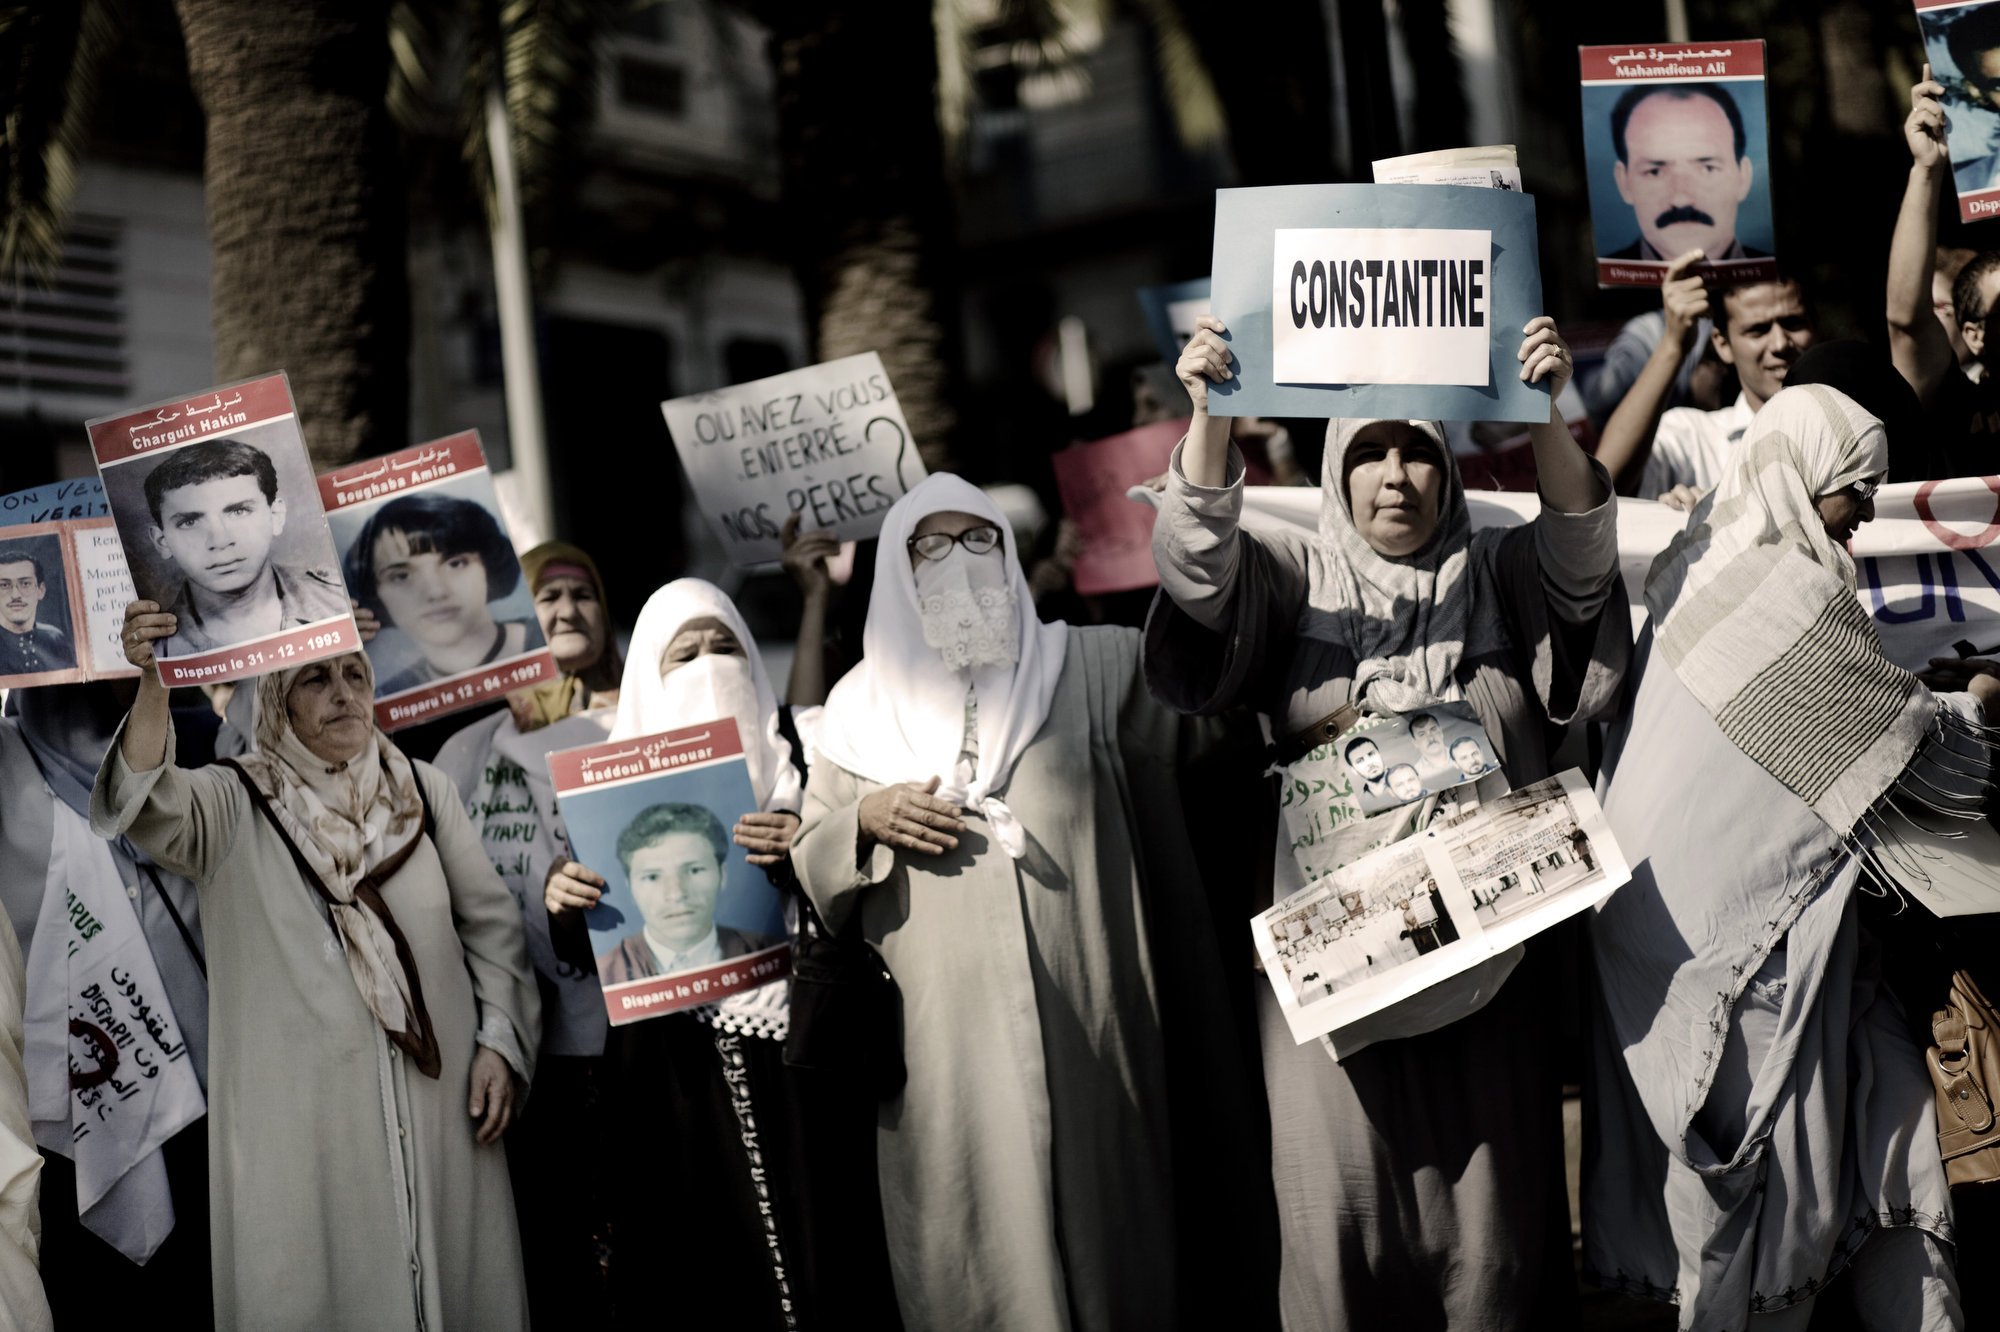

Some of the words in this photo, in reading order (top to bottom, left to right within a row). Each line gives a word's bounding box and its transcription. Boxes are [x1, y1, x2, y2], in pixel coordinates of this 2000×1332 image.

[1616, 62, 1703, 78] Mahamdioua
[1706, 62, 1726, 75] Ali
[1969, 200, 2000, 214] Disp
[1290, 260, 1484, 329] CONSTANTINE
[129, 408, 181, 438] حكيم
[741, 394, 807, 437] AVEZ
[816, 375, 887, 415] VOUS
[132, 424, 196, 450] Charguit
[200, 410, 247, 432] Hakim
[3, 493, 39, 510] ON
[57, 482, 103, 500] VEU
[337, 476, 405, 505] Boughaba
[411, 462, 456, 484] Amina
[720, 502, 780, 543] NOS
[92, 601, 107, 612] de
[97, 583, 118, 599] par
[174, 662, 227, 680] Disparu
[231, 658, 244, 671] le
[248, 651, 264, 666] 31
[278, 643, 295, 658] 12
[308, 631, 341, 650] 1993
[389, 696, 439, 721] Disparu
[441, 691, 454, 705] le
[484, 677, 500, 692] 04
[511, 662, 542, 686] 1997
[582, 758, 644, 784] Maddoui
[649, 746, 713, 770] Menouar
[622, 987, 674, 1011] Disparu
[676, 983, 690, 998] le
[692, 978, 710, 994] 07
